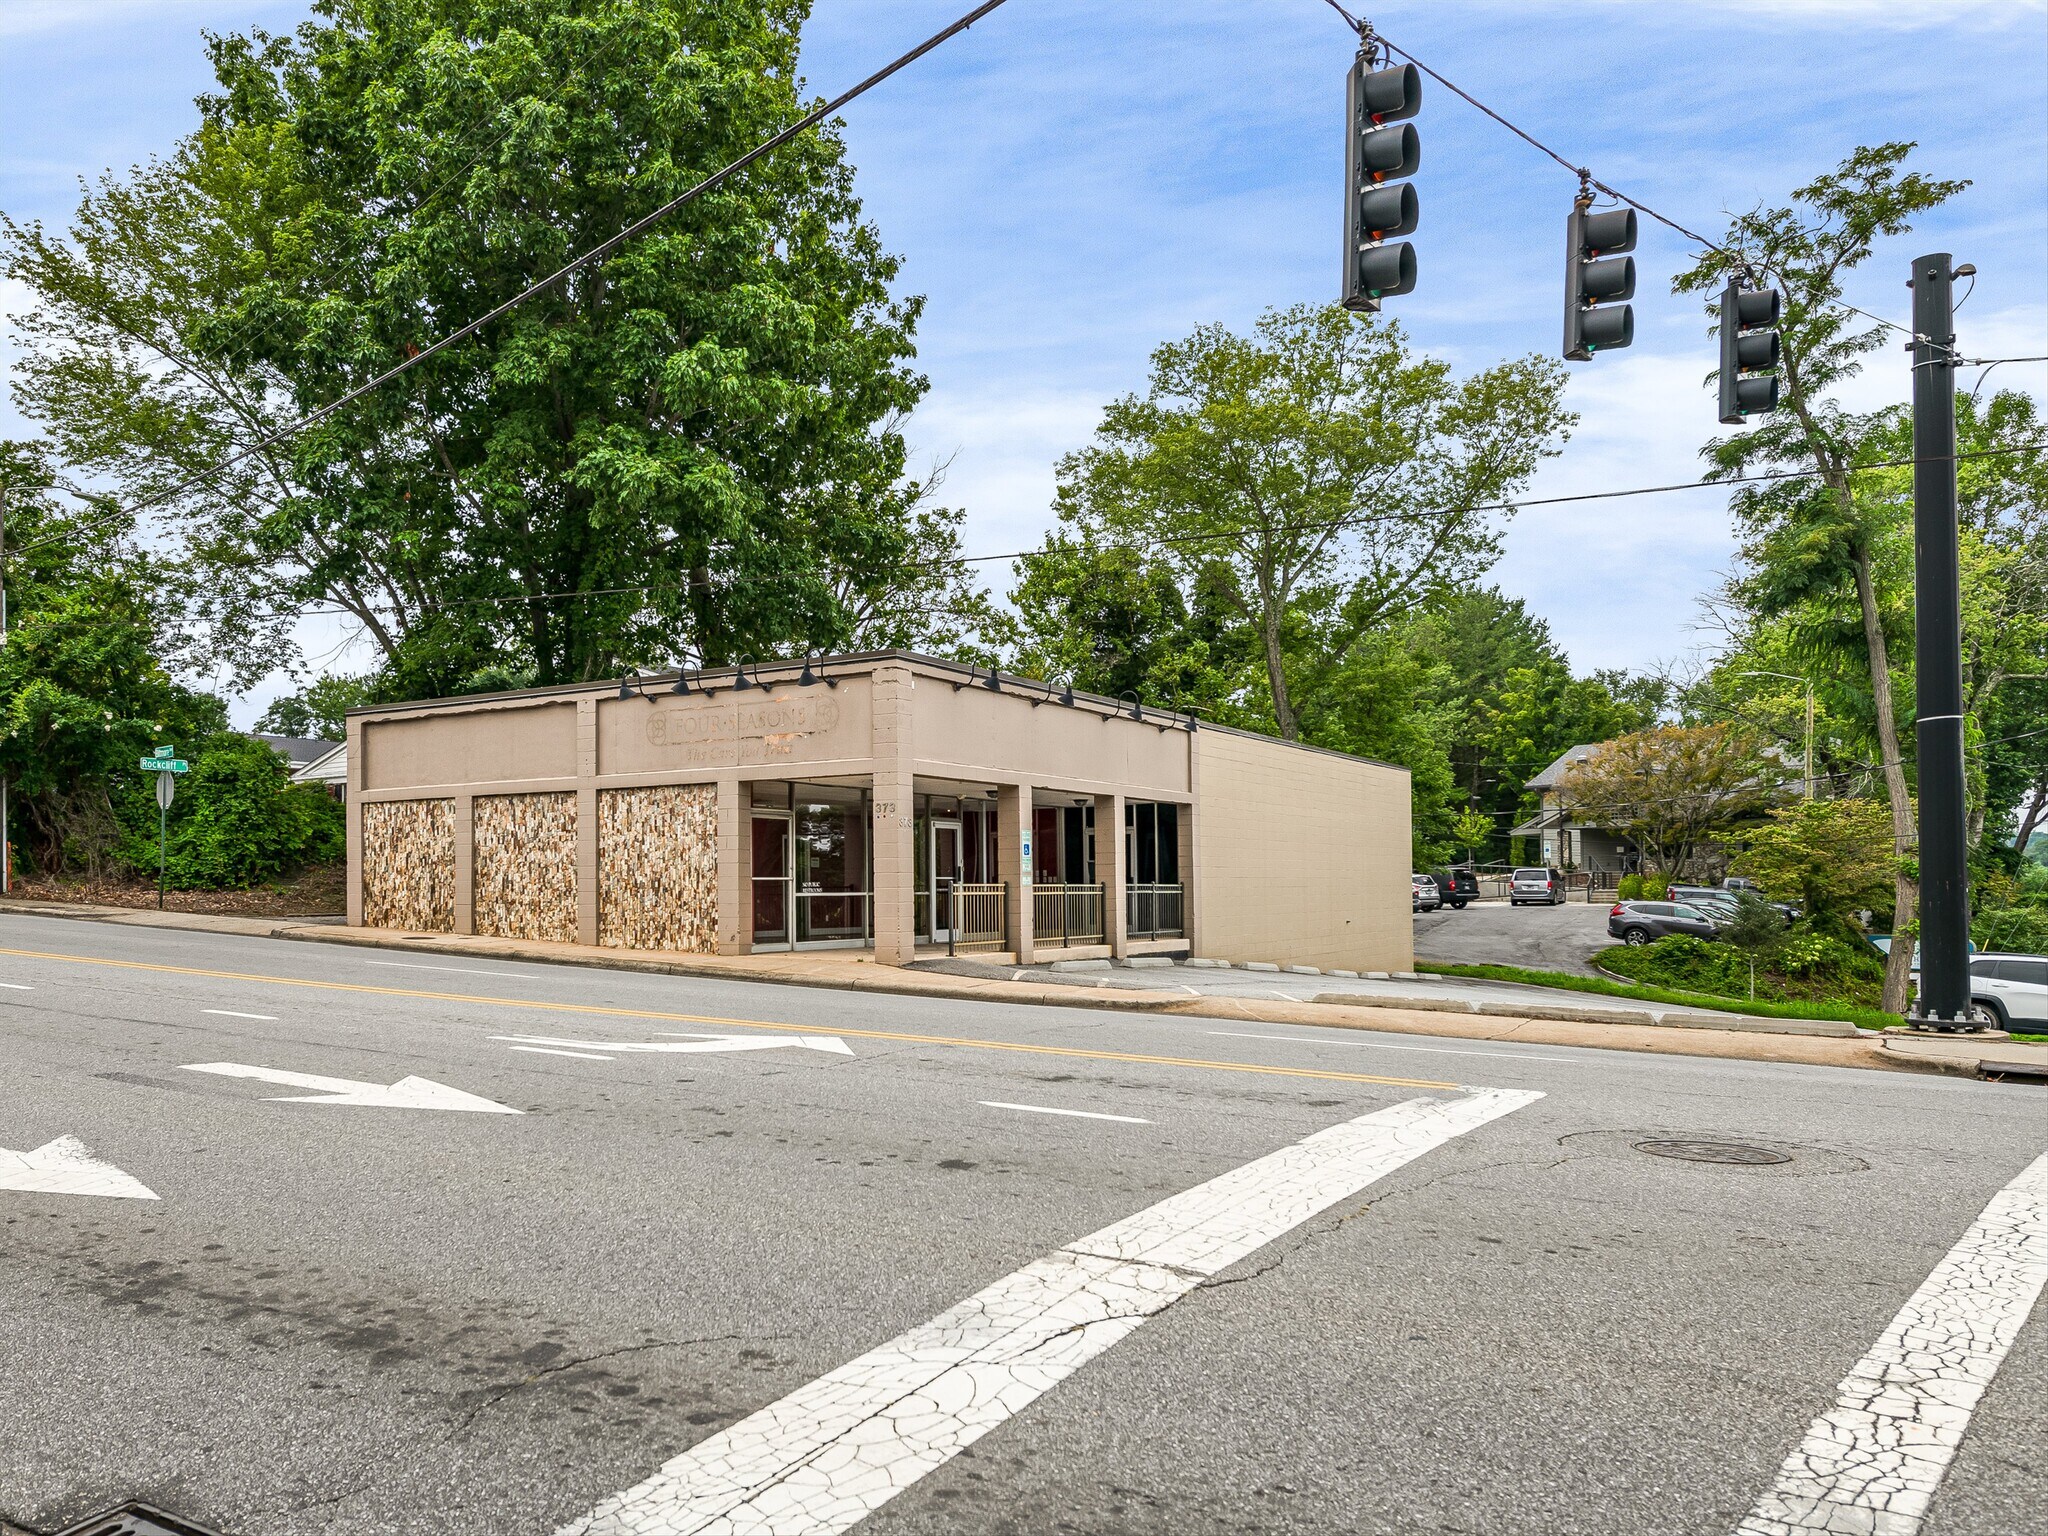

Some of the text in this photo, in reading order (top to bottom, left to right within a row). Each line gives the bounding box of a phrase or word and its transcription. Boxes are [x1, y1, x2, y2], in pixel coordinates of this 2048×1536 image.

[674, 708, 806, 736] FOUR SEASONS
[142, 759, 177, 770] Rockcliff
[875, 802, 896, 813] 373
